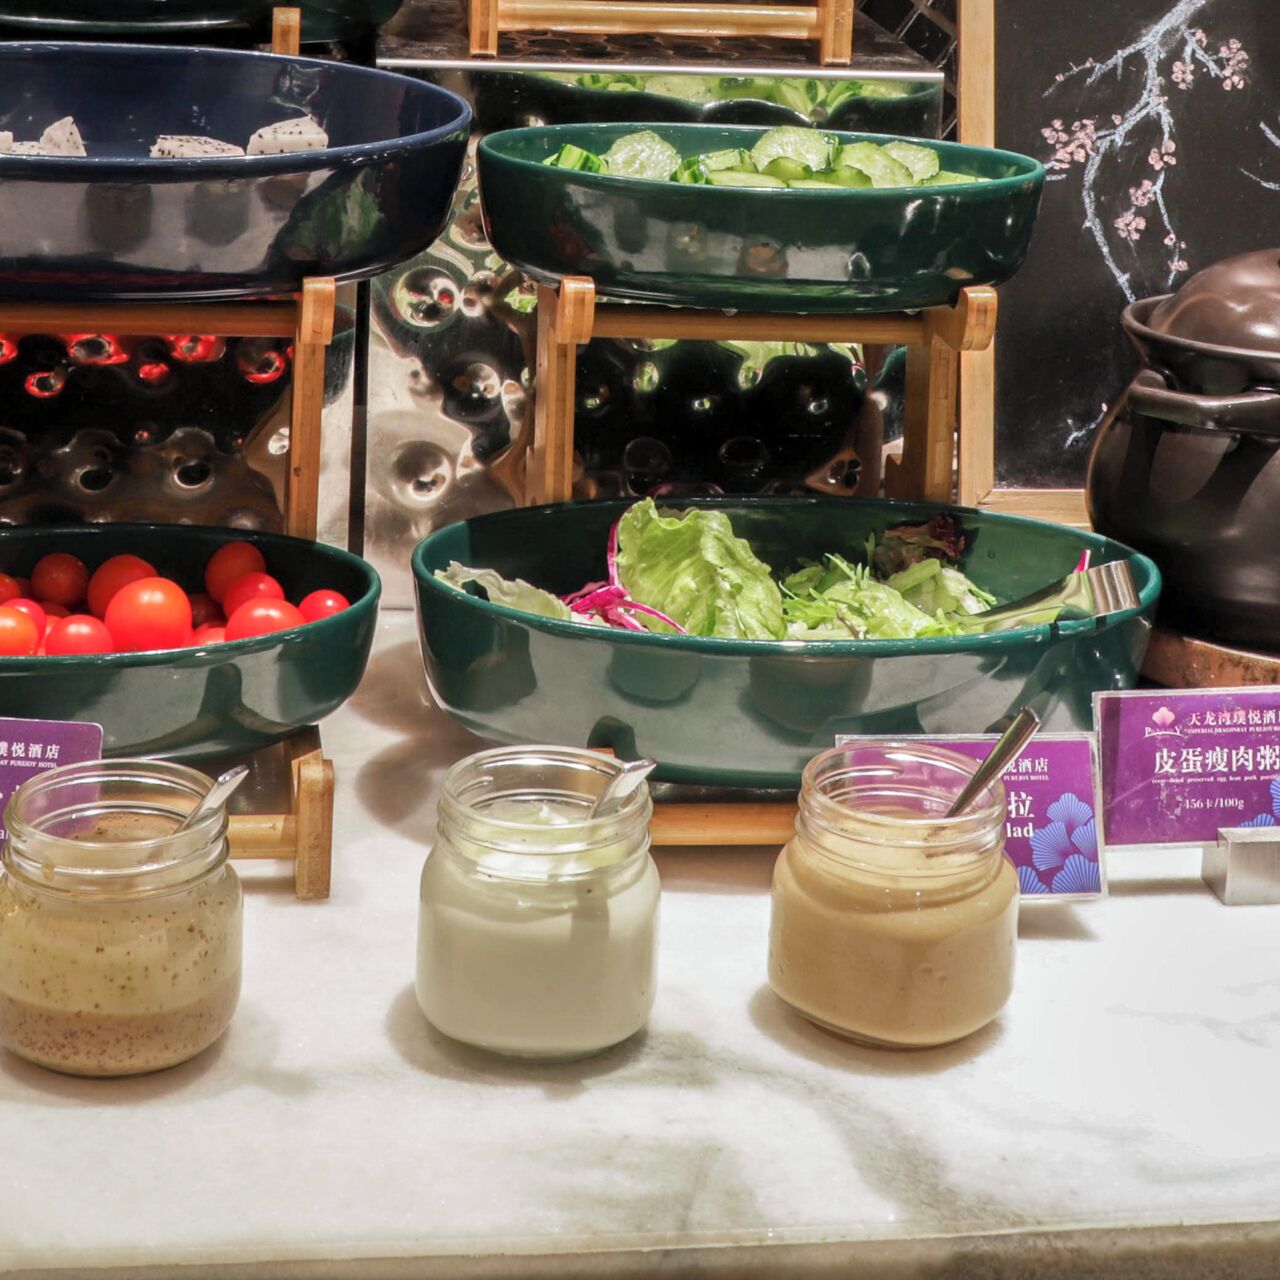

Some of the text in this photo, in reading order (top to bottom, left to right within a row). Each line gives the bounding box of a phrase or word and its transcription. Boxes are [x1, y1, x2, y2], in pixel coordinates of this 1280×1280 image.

[1153, 745, 1280, 774] 皮蛋瘦肉粥
